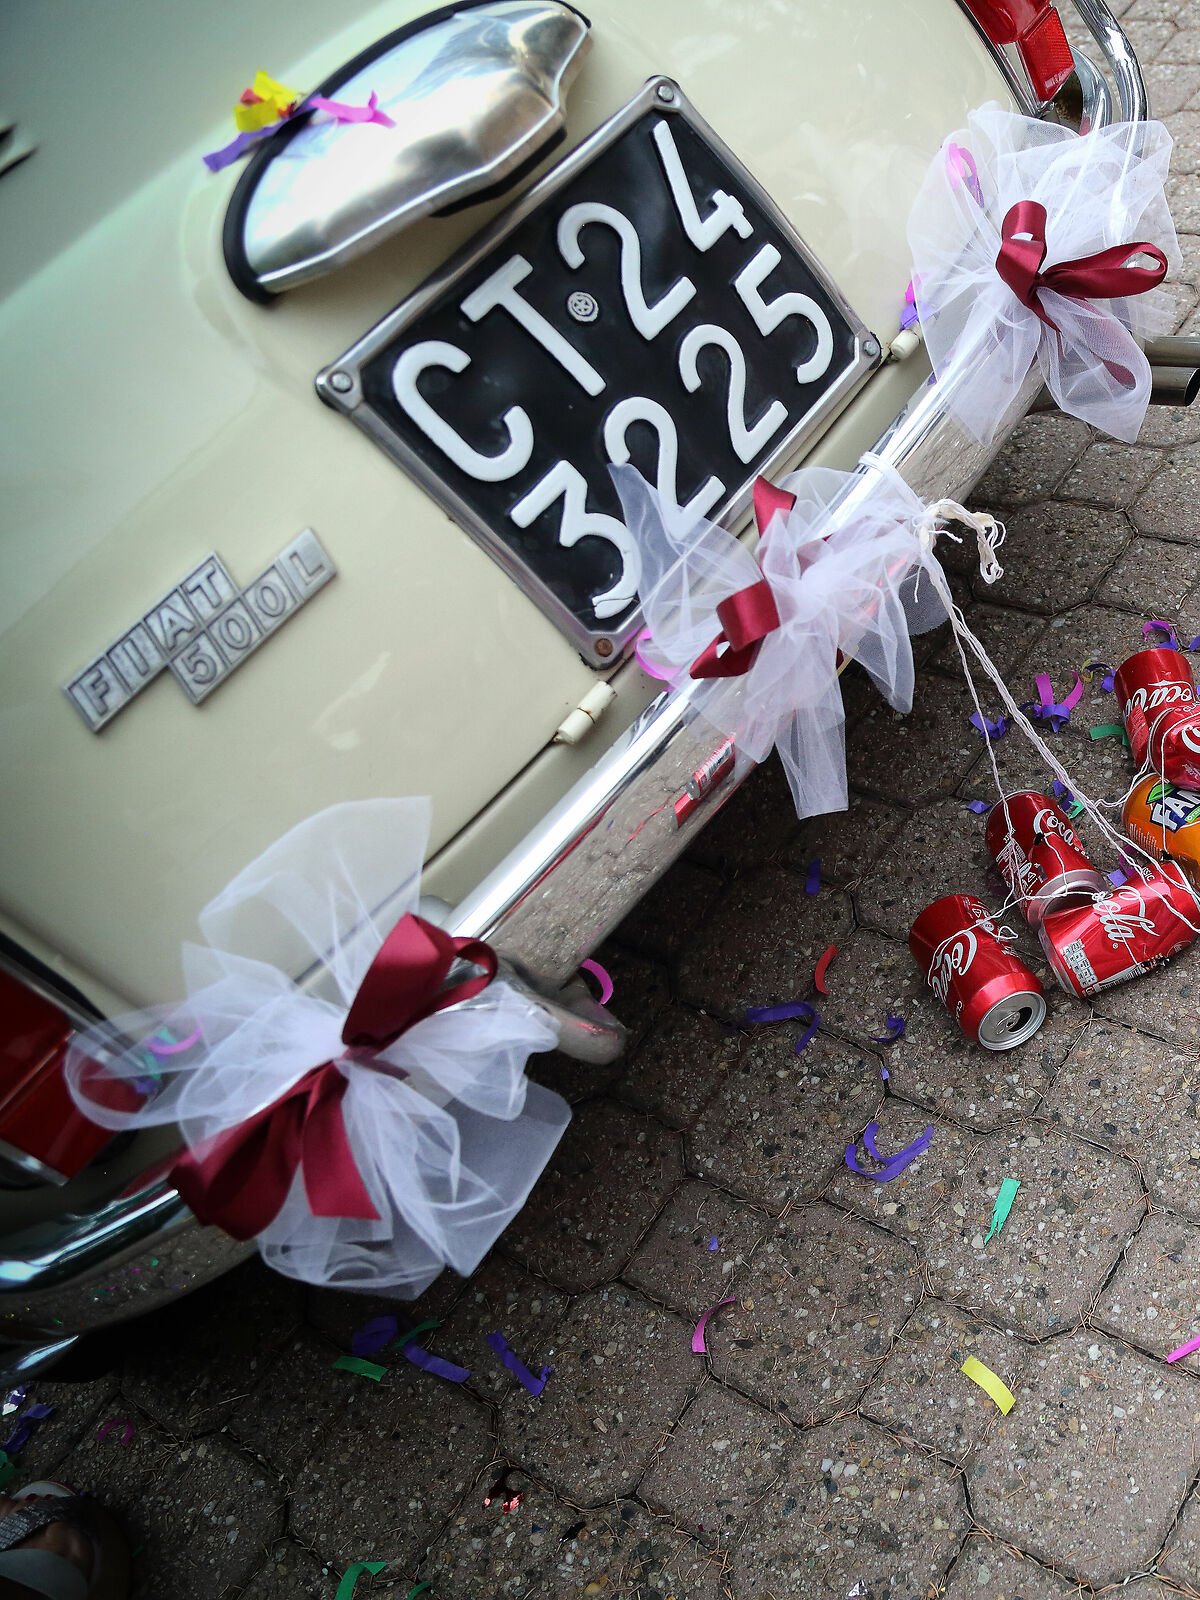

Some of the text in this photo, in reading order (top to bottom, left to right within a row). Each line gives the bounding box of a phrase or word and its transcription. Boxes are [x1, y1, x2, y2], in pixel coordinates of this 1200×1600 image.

[392, 120, 755, 482] CT 24
[510, 243, 835, 619] 3225
[81, 564, 223, 717] FIAT
